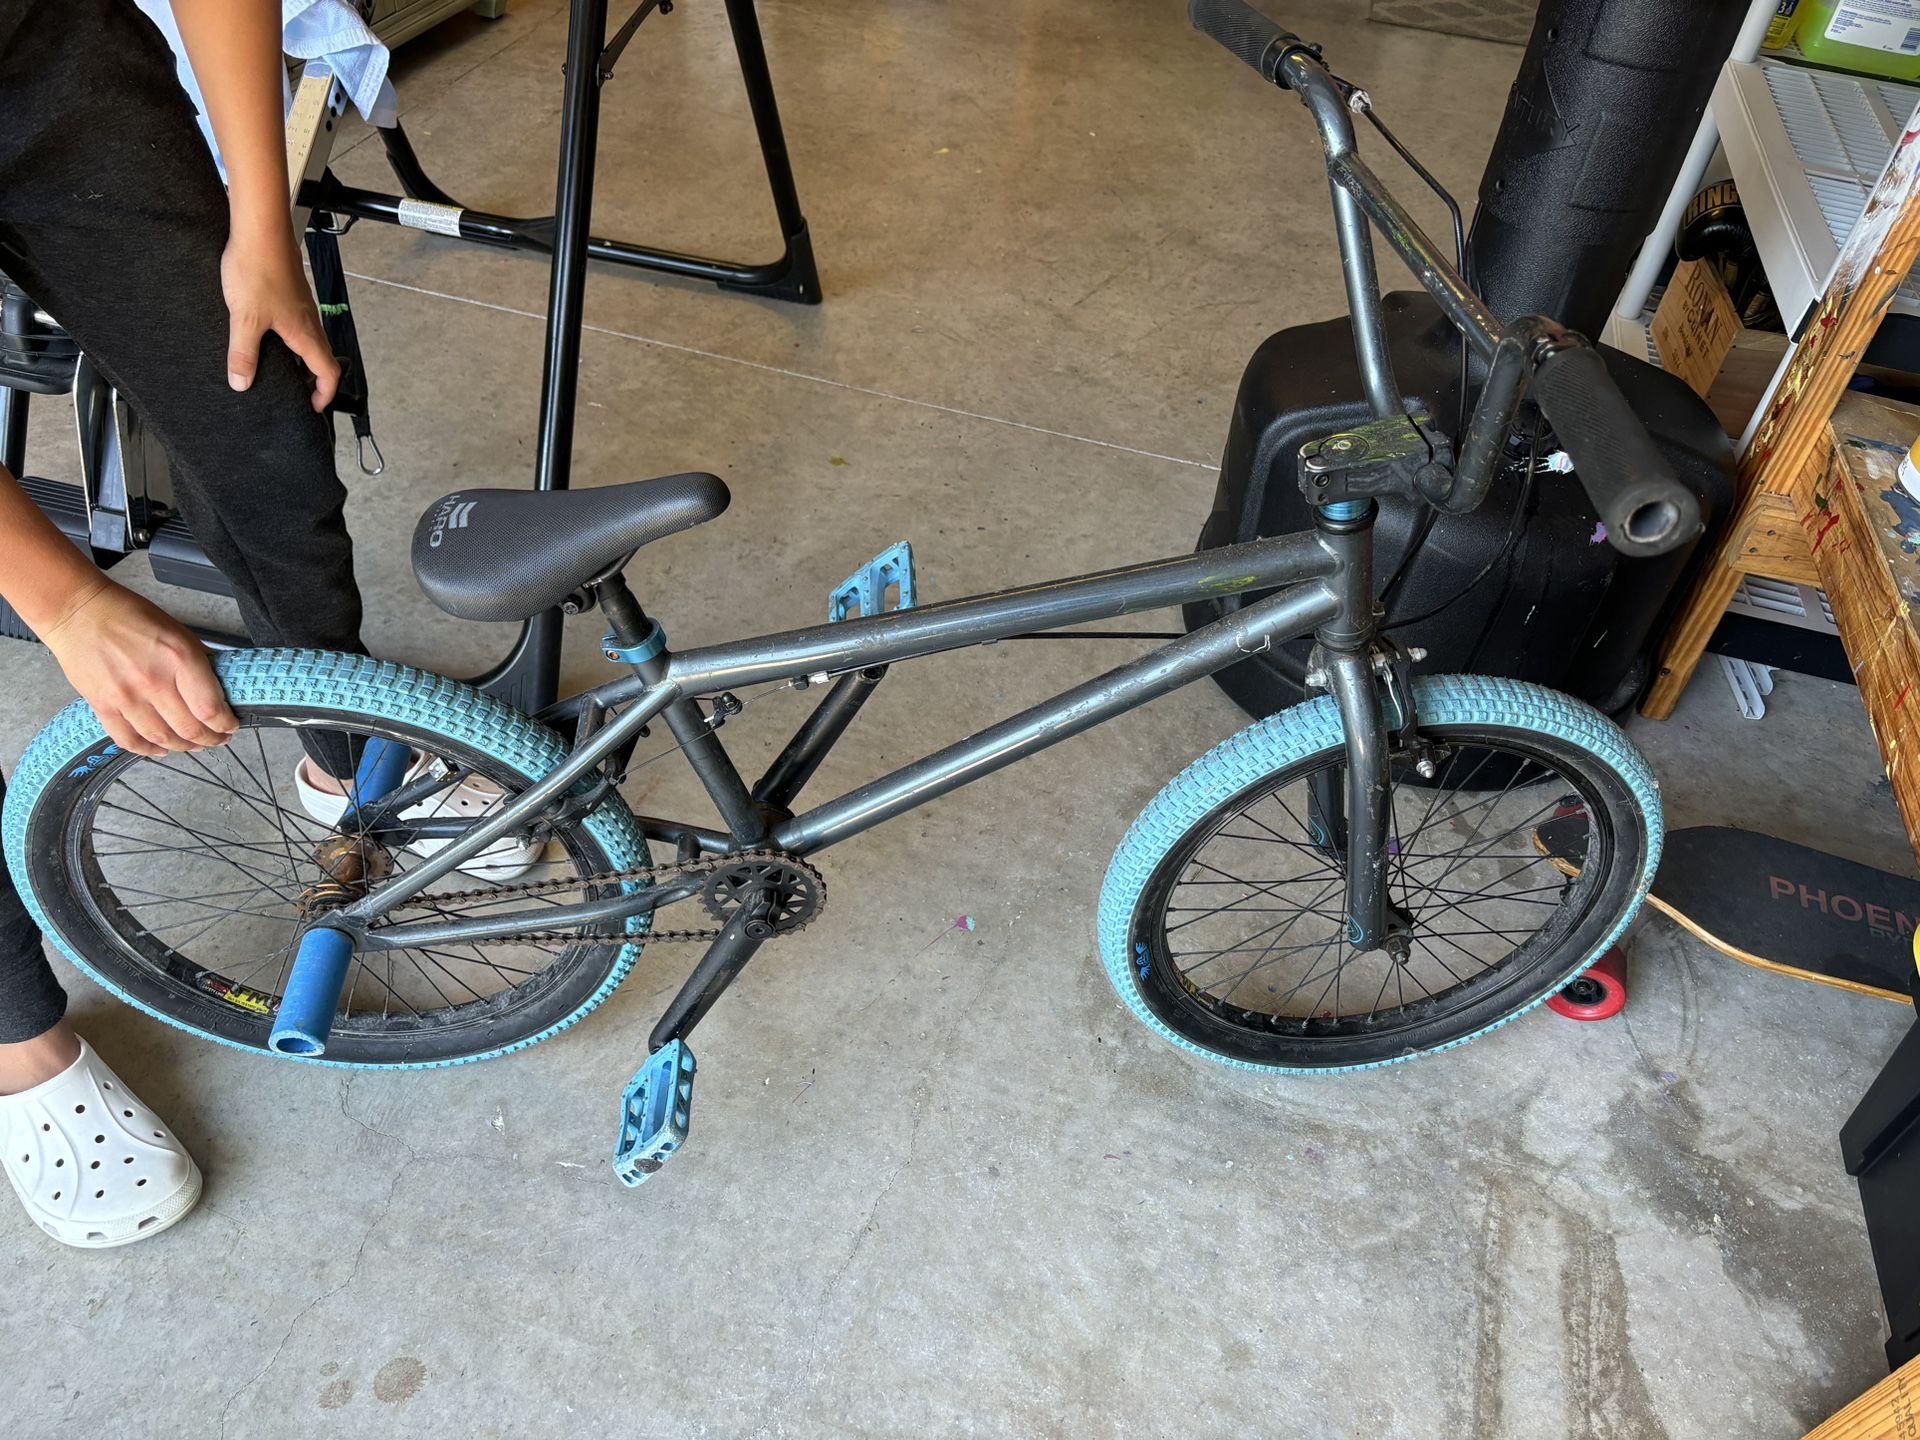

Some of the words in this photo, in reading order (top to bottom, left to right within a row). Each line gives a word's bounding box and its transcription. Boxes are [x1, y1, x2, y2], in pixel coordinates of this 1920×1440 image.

[1685, 262, 1723, 346] RONAN
[430, 495, 461, 548] HARO
[1769, 875, 1920, 936] PHOEN
[1897, 1377, 1916, 1437] QUALITY
